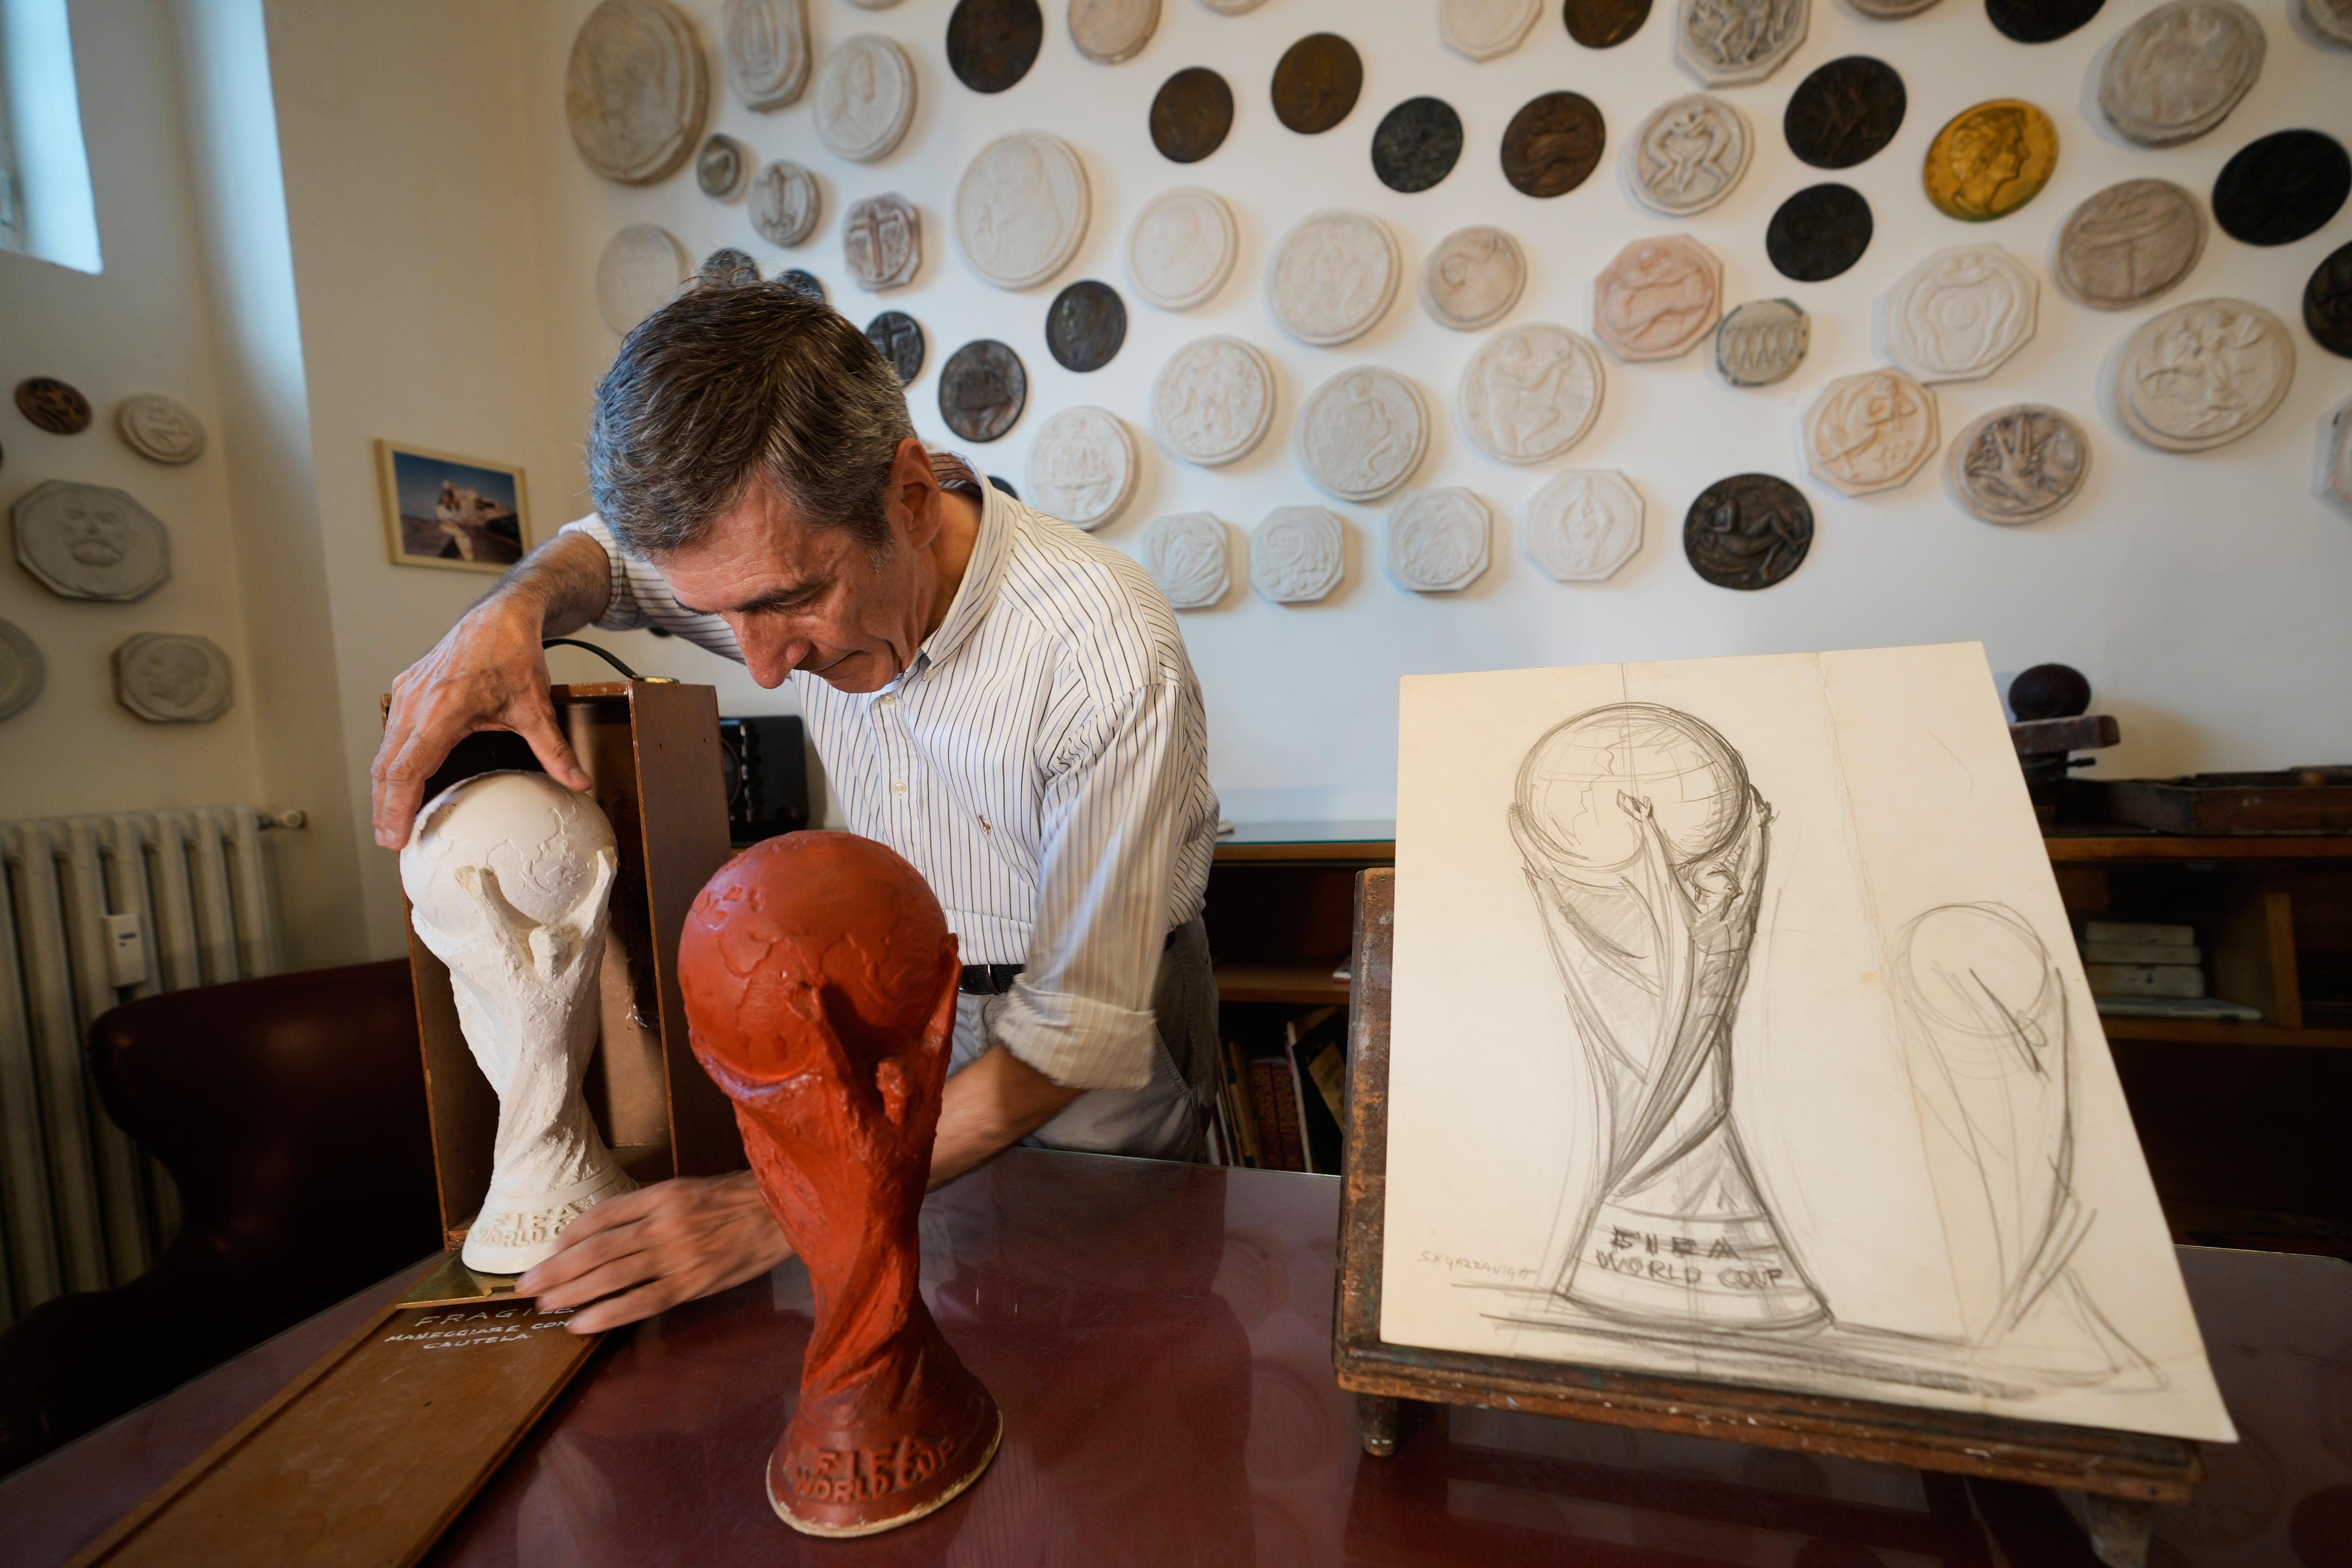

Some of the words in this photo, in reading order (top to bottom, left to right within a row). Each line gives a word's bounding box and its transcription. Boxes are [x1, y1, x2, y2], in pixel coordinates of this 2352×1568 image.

[494, 1204, 580, 1230] FIFA
[475, 1226, 546, 1248] WORLD
[1596, 1249, 1701, 1284] WORLD
[384, 1325, 520, 1342] MANEGGIARE
[531, 1320, 572, 1329] CON
[795, 1465, 891, 1504] WORLD
[898, 1439, 956, 1487] CUP
[815, 1435, 932, 1482] FIFA
